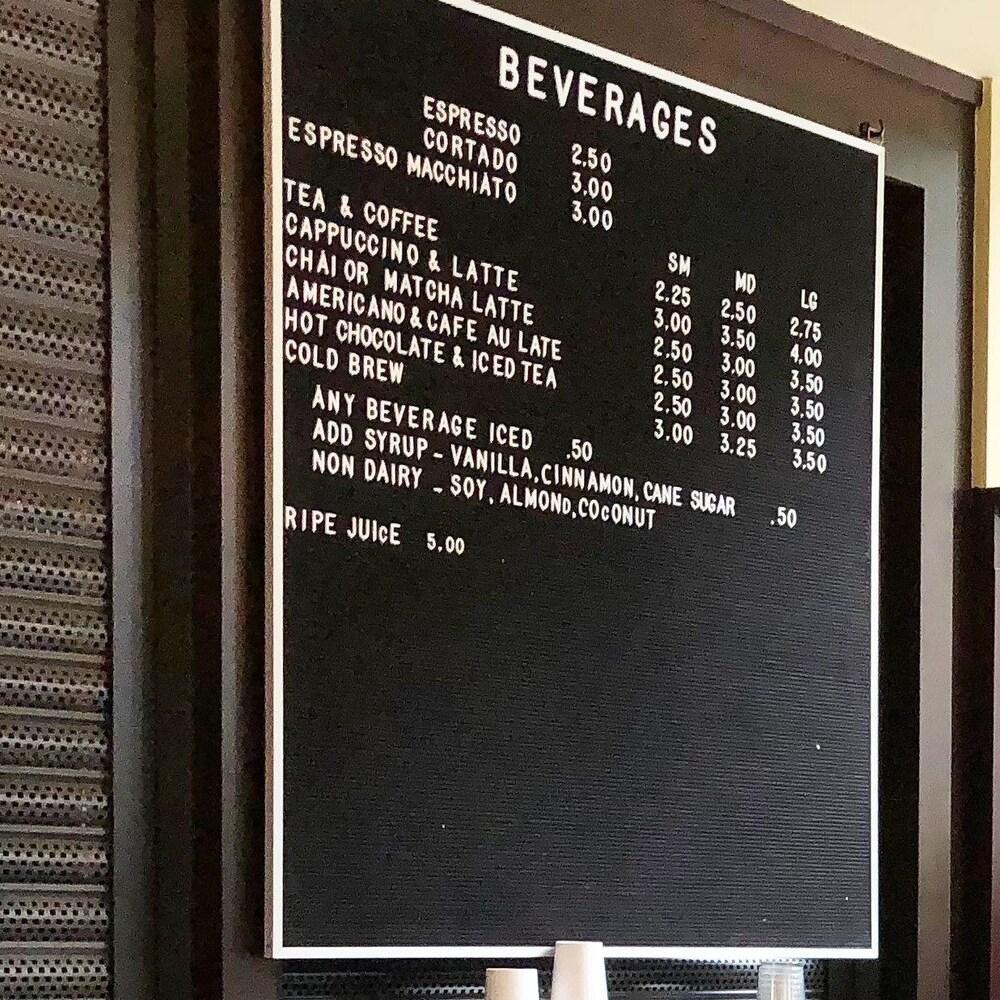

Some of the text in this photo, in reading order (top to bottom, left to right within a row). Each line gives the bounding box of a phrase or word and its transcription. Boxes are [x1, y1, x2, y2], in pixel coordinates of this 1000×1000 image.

[423, 95, 612, 174] ESPRESSO 2.50
[498, 45, 717, 155] BEVERAGES
[288, 116, 613, 231] ESPRESSO MACCHIATO 3.00
[423, 127, 613, 203] CORTADO 3.00
[283, 177, 822, 343] TEA & COFFEE 2.25 2.50 2.75
[285, 211, 823, 369] CAPPUCCINO & LATTE 3.00 3.50 4.00
[667, 251, 818, 312] SM MD LG
[285, 244, 824, 396] CHAI OR MATCHA LATTE 2.50 3.00 3.50
[286, 275, 825, 422] AMERICANO & CAFE AU LATE 2.50 3.00 3.50
[284, 306, 826, 448] HOT CHOCOLATE & ICED TEA 2.50 3.00 3.50
[284, 338, 827, 475] COLD BREW 3.00 3.25 3.50
[311, 384, 593, 463] ANY BEVERAGE ICED .50
[312, 448, 355, 479] NON
[364, 457, 423, 489] DAIRY
[312, 417, 353, 447] ADD
[364, 428, 429, 461] SYRUP
[642, 480, 683, 507] CANE
[689, 489, 736, 518] SUGAR
[770, 506, 798, 529] .50
[284, 505, 337, 536] RIPE
[426, 532, 465, 555] 5.00
